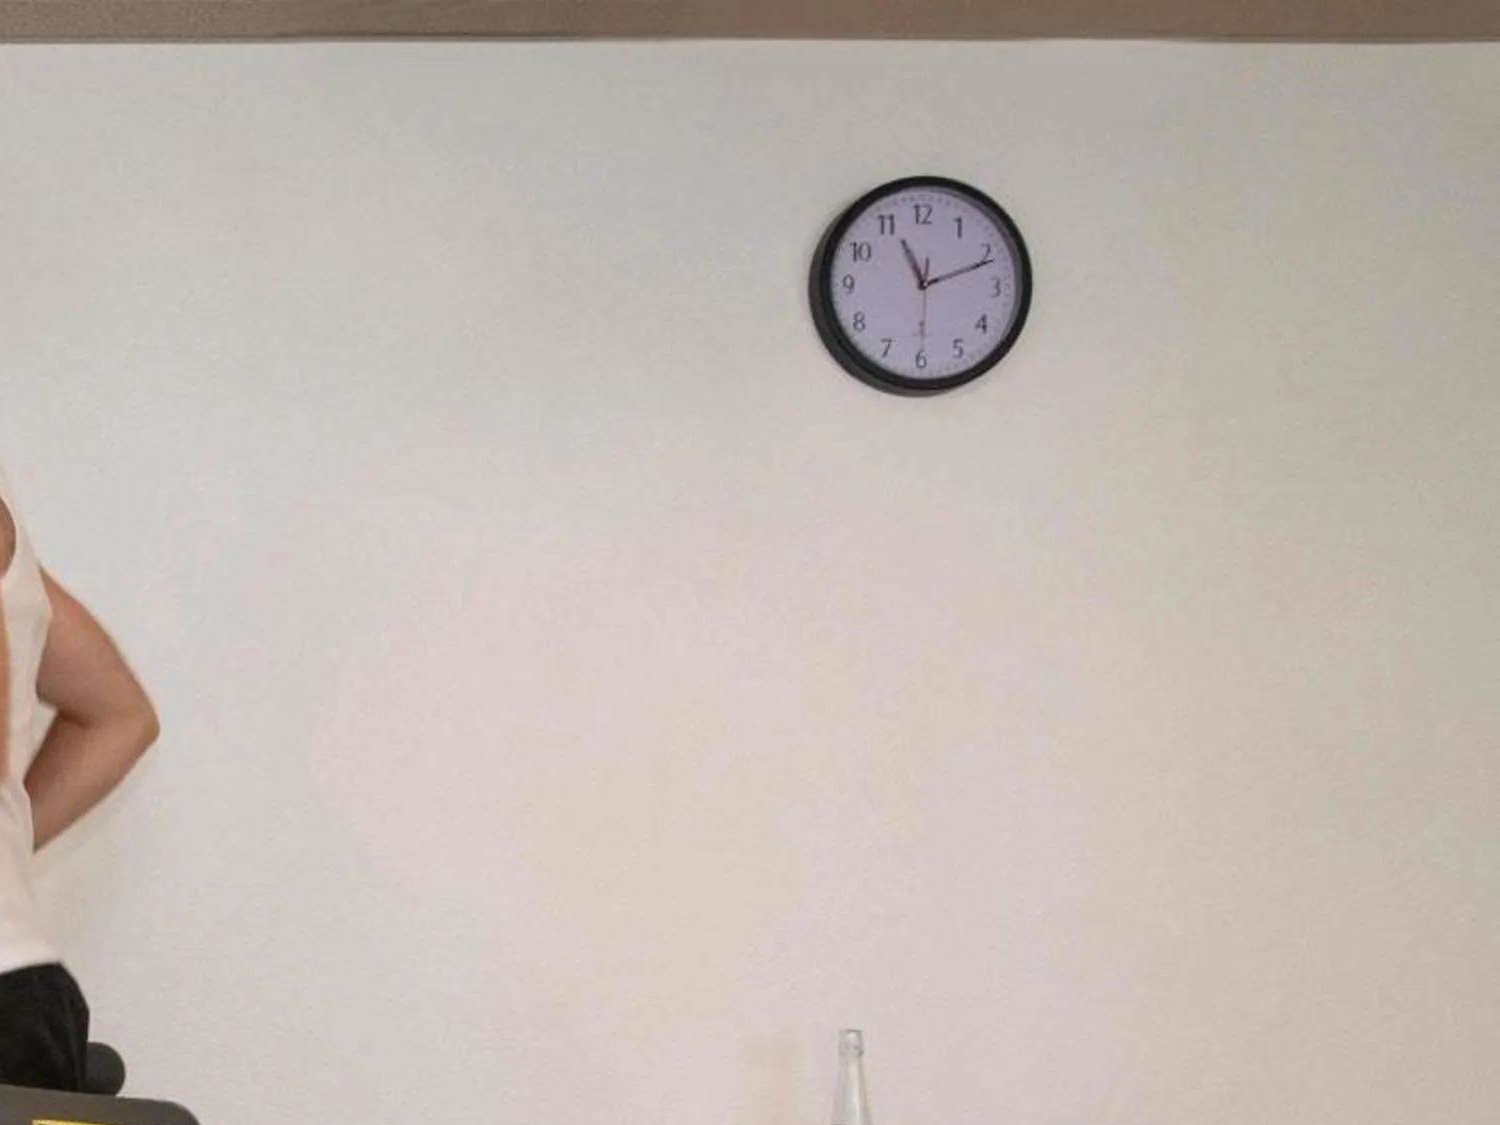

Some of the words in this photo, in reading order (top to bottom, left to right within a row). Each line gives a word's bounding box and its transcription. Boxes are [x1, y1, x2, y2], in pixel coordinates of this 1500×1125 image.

[878, 214, 895, 235] 11
[913, 204, 932, 225] 12
[954, 217, 963, 239] 1
[851, 242, 872, 262] 10
[980, 243, 993, 263] 2
[842, 276, 855, 294] 9
[990, 277, 1001, 298] 3
[852, 311, 866, 332] 8
[975, 314, 988, 334] 4
[881, 338, 893, 358] 7
[953, 339, 964, 359] 5
[915, 350, 927, 369] 6
